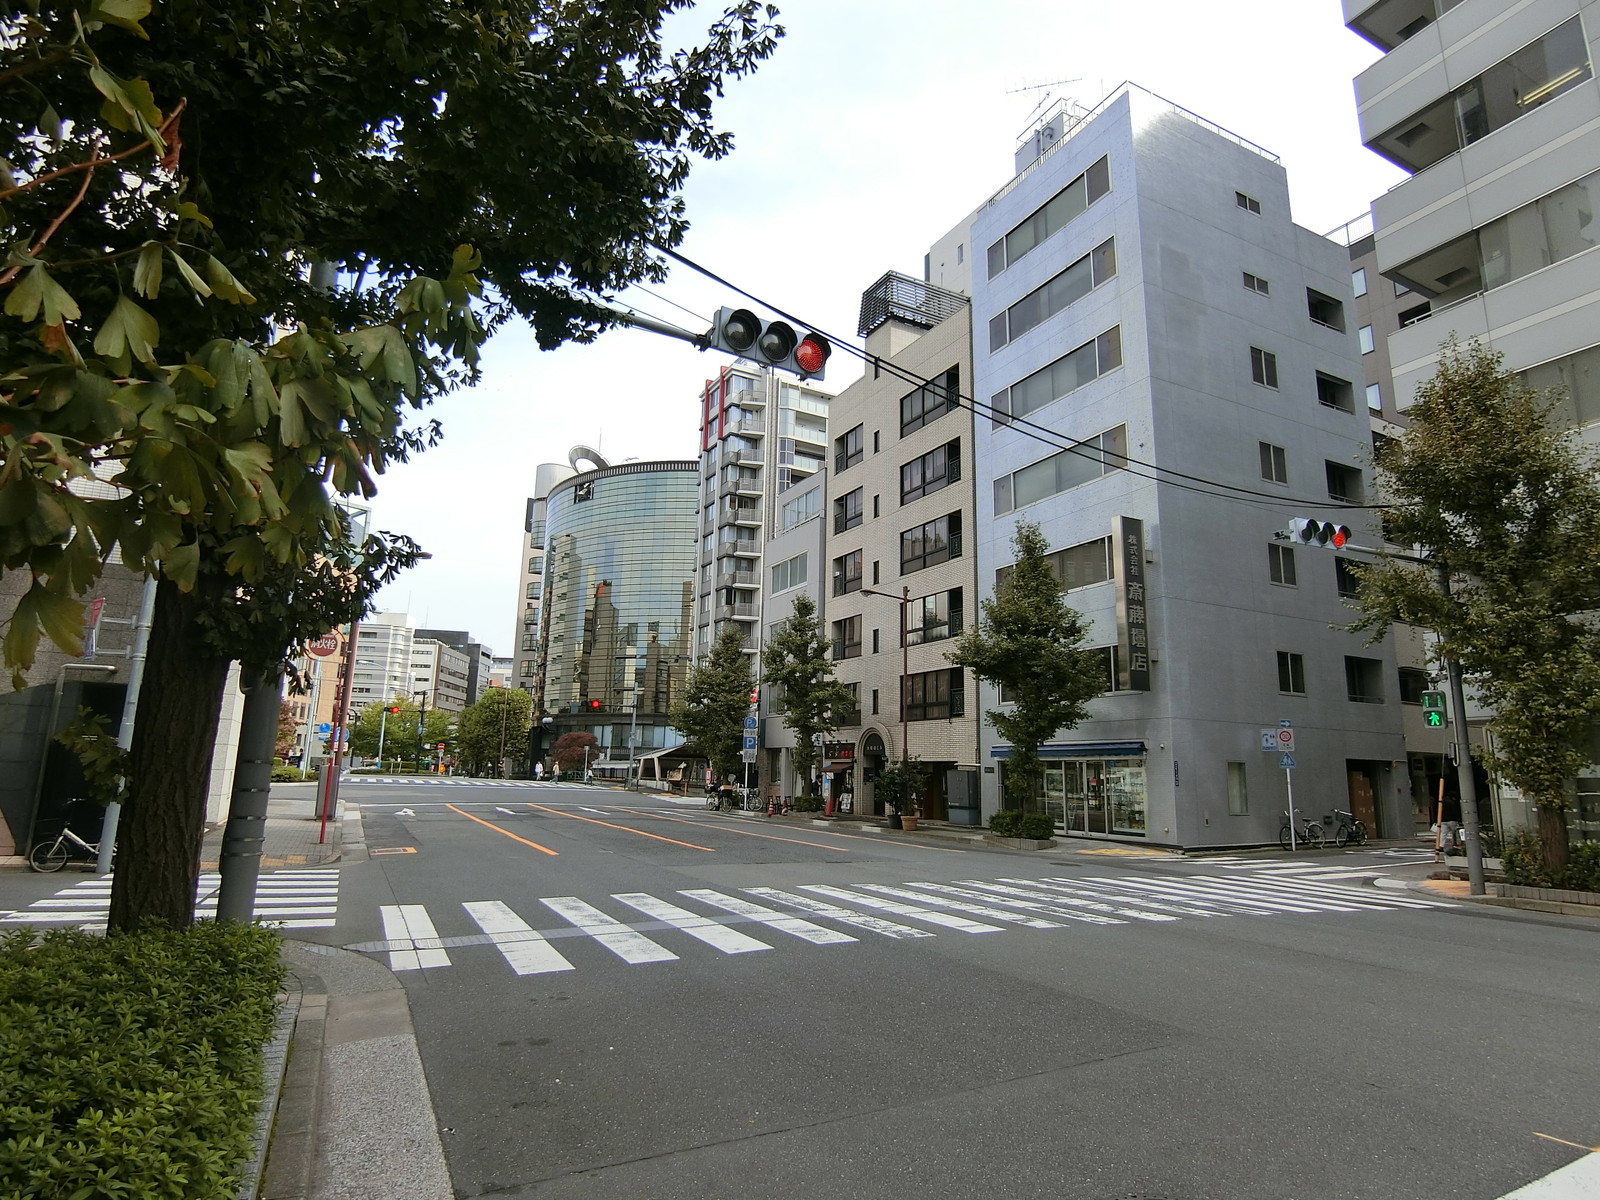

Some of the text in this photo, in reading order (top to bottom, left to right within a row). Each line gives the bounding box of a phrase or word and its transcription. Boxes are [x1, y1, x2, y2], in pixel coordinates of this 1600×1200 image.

[1128, 534, 1139, 576] 株式会社
[746, 738, 755, 748] P
